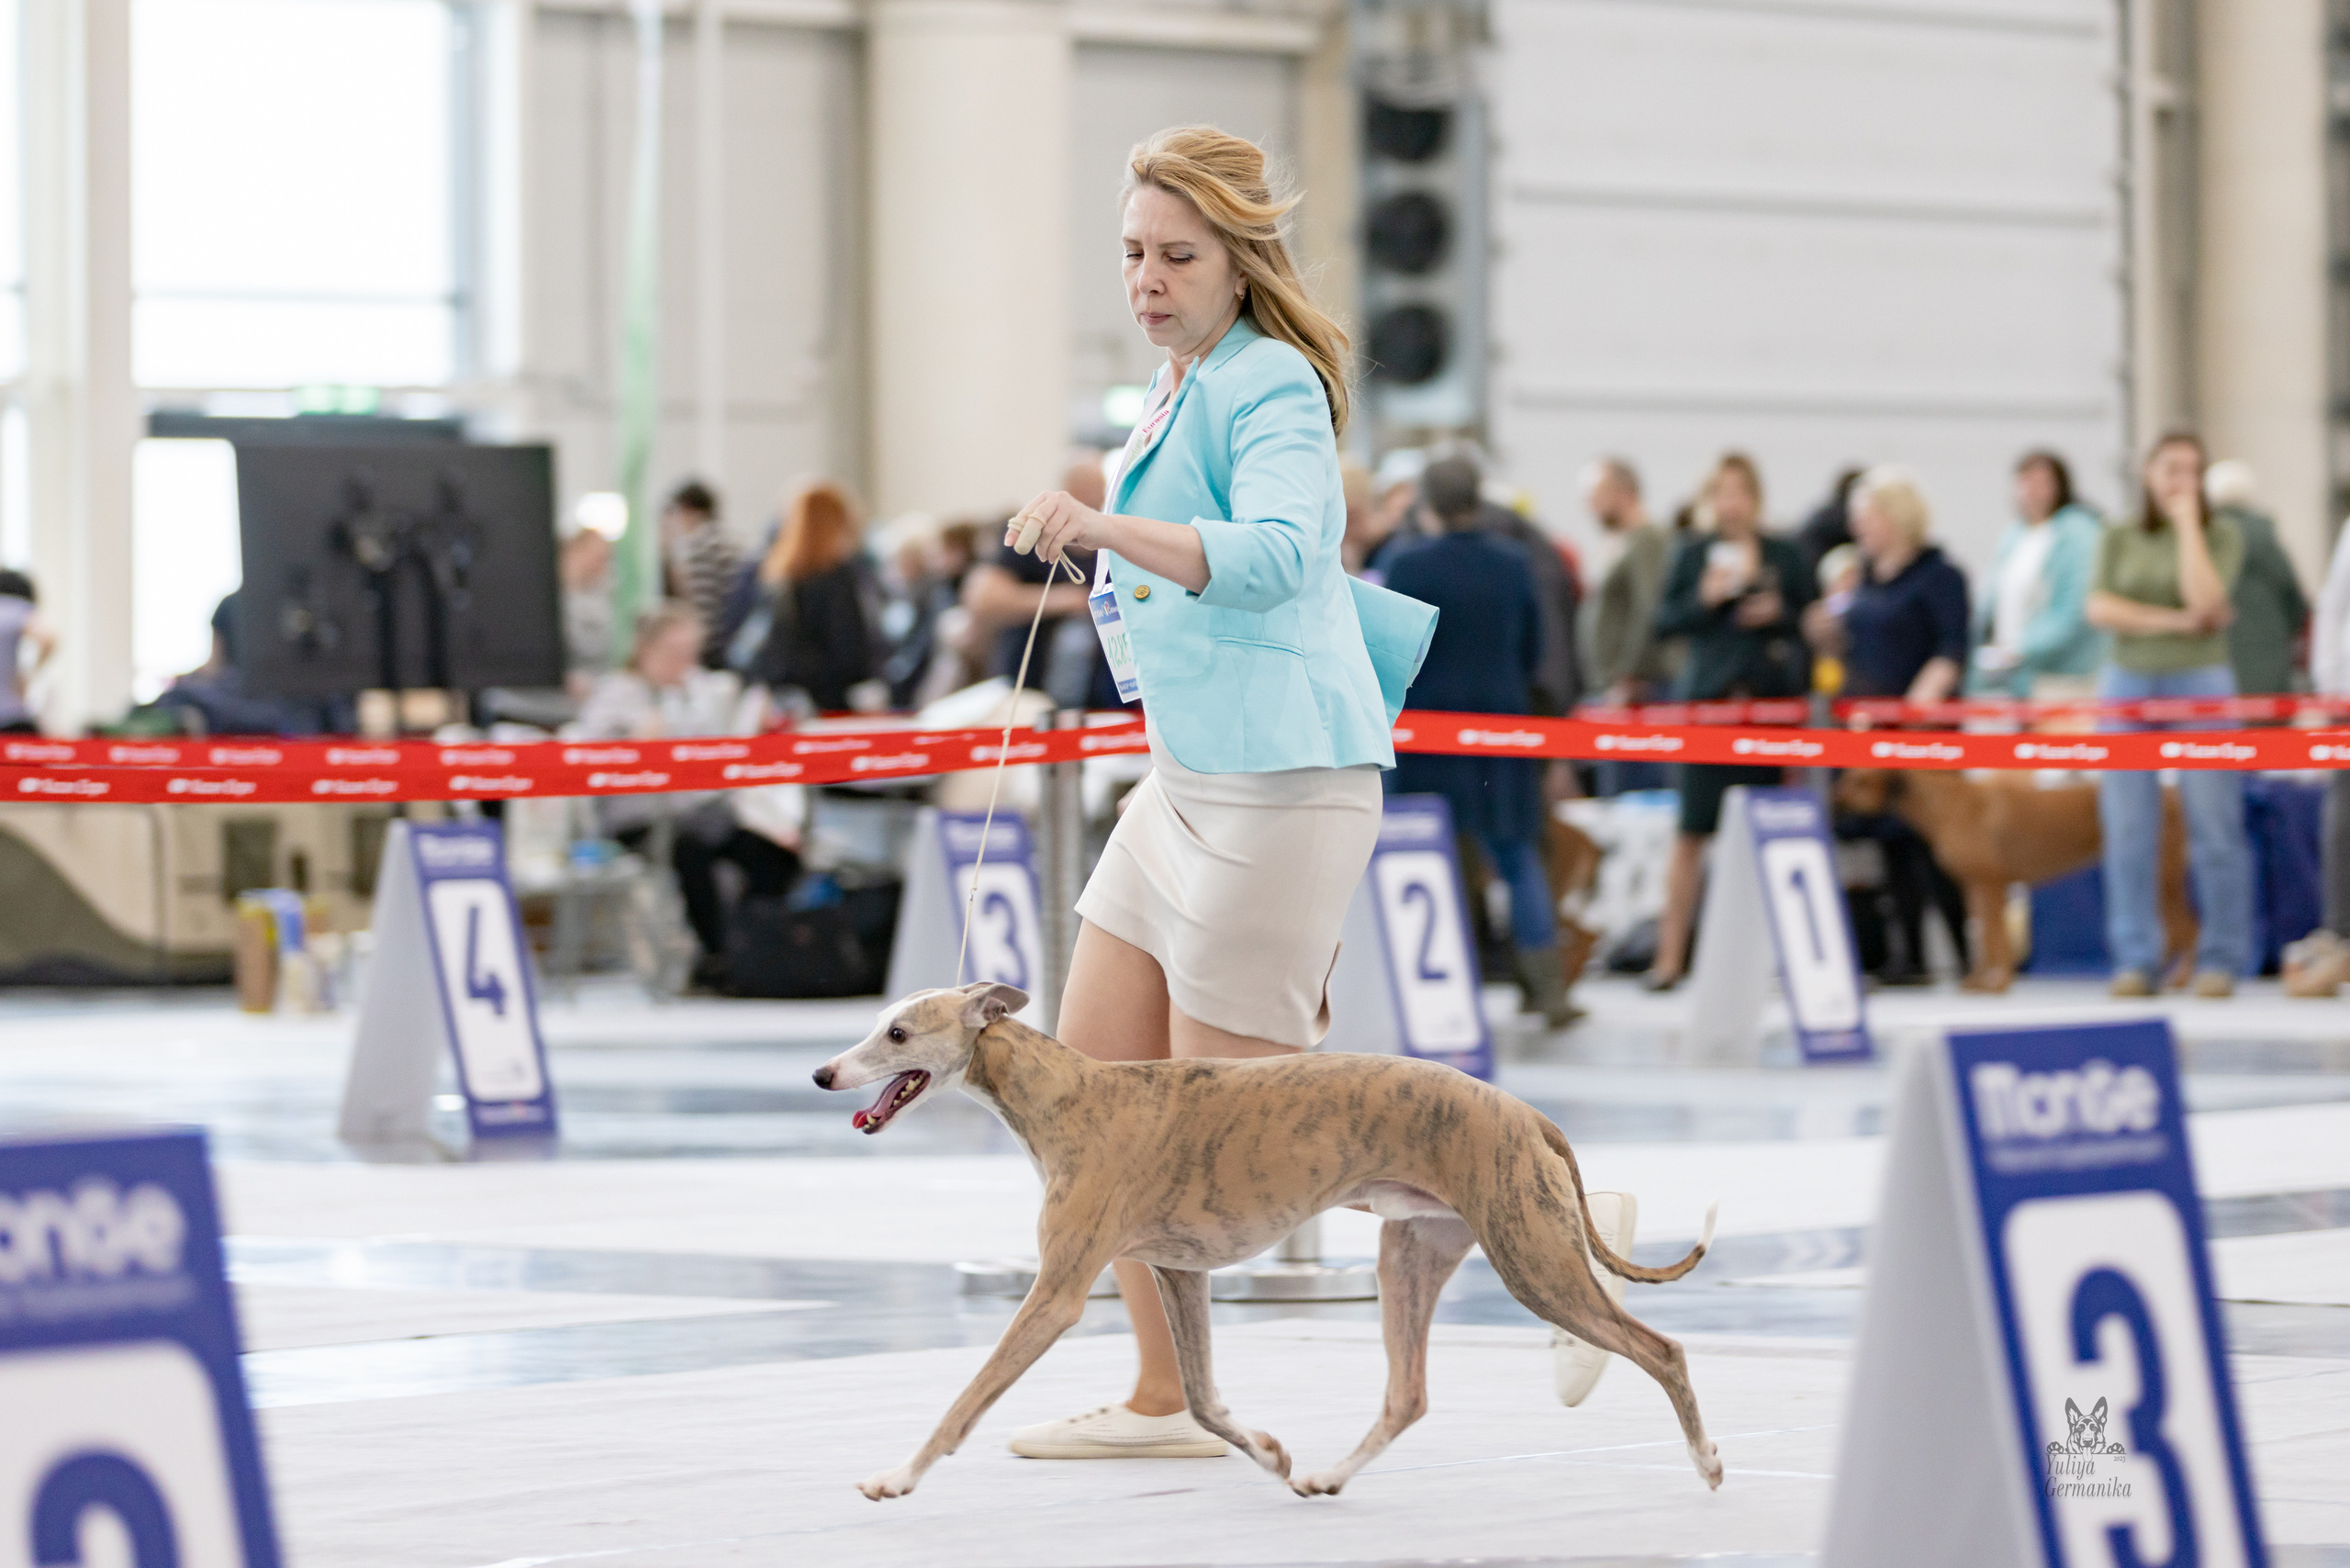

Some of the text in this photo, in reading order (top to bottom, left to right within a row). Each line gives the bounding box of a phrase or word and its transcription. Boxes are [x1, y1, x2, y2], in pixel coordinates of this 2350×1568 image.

[1142, 409, 1170, 434] Eurasia
[466, 904, 506, 1015] 4
[983, 891, 1029, 991] 3
[1401, 879, 1449, 980] 2
[1789, 867, 1825, 961] 1
[2066, 1263, 2201, 1568] 3
